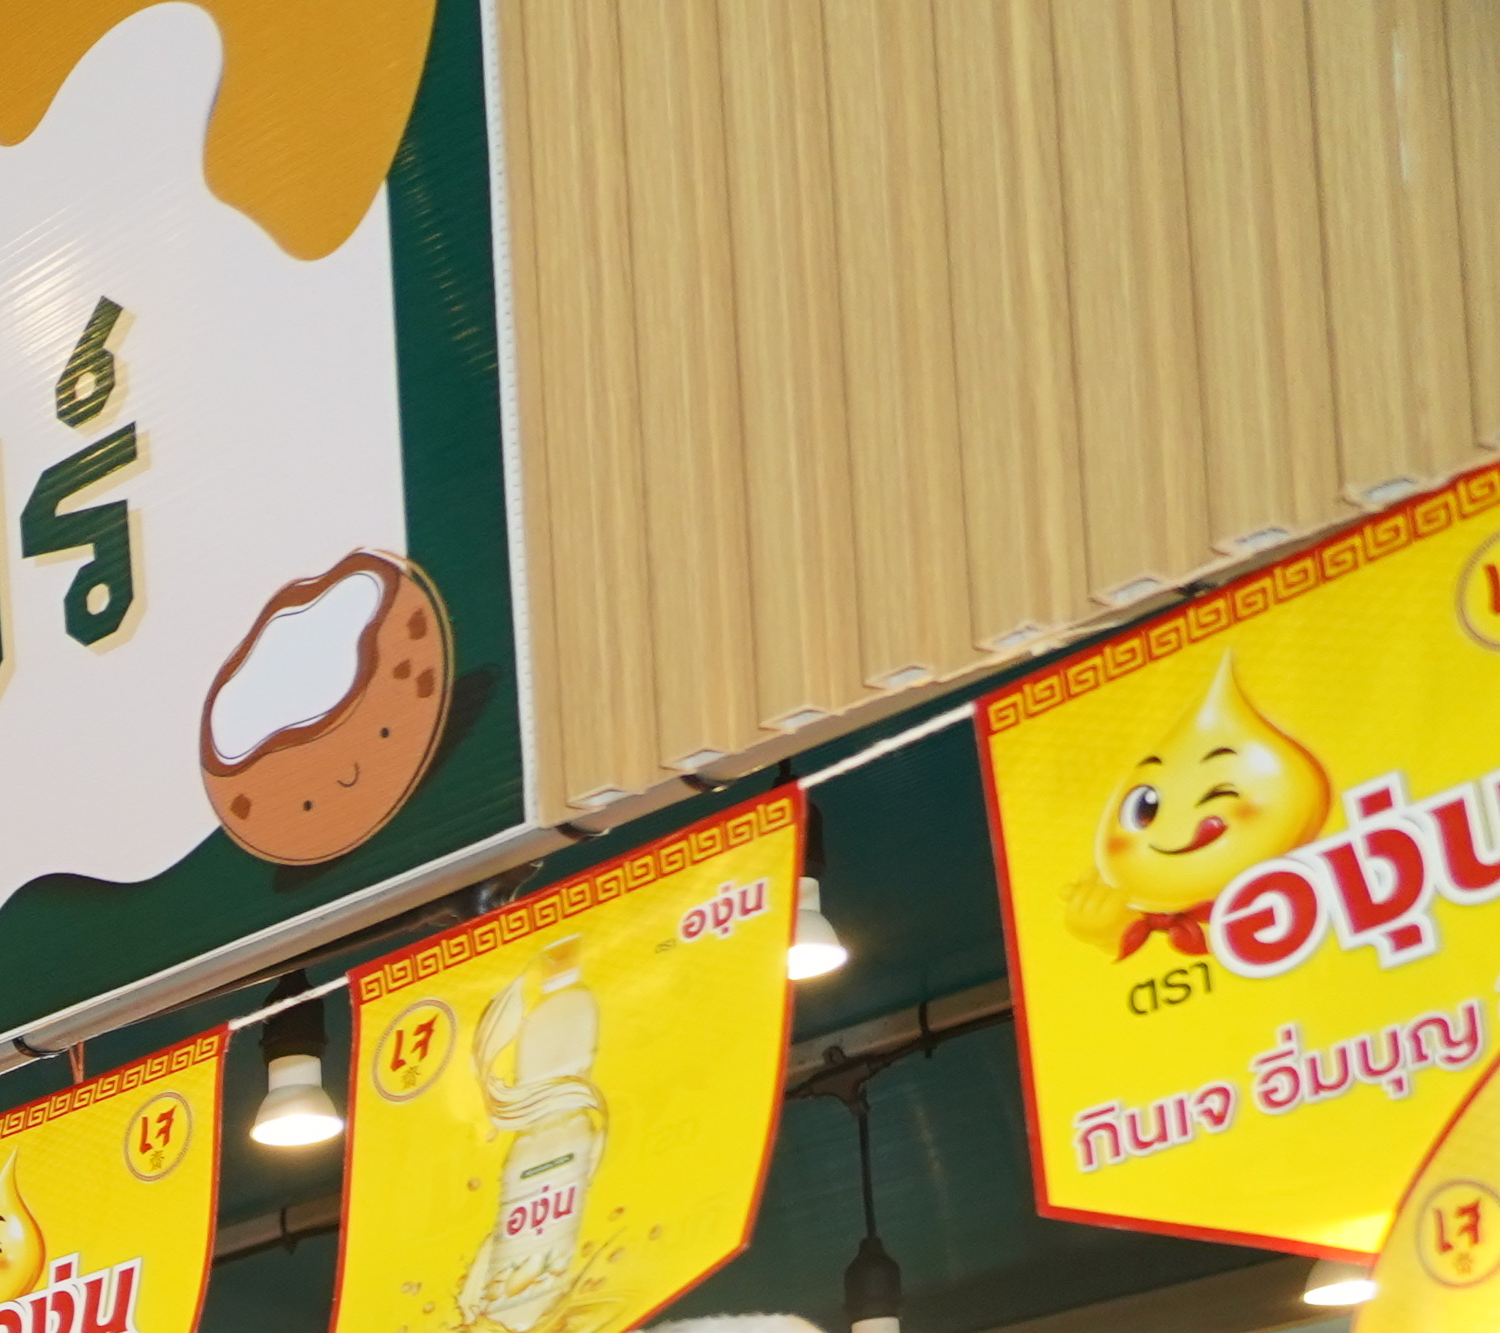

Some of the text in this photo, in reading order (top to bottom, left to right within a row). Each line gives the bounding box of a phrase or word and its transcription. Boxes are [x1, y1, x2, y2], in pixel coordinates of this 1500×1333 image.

[678, 877, 770, 943] องุ่น
[1127, 772, 1500, 1018] ตรา องุ่น
[389, 1012, 441, 1074] เจ
[1073, 997, 1484, 1171] กินเจ อิ่มบุญ
[139, 1105, 176, 1154] เจ
[506, 1184, 577, 1237] องุ่น
